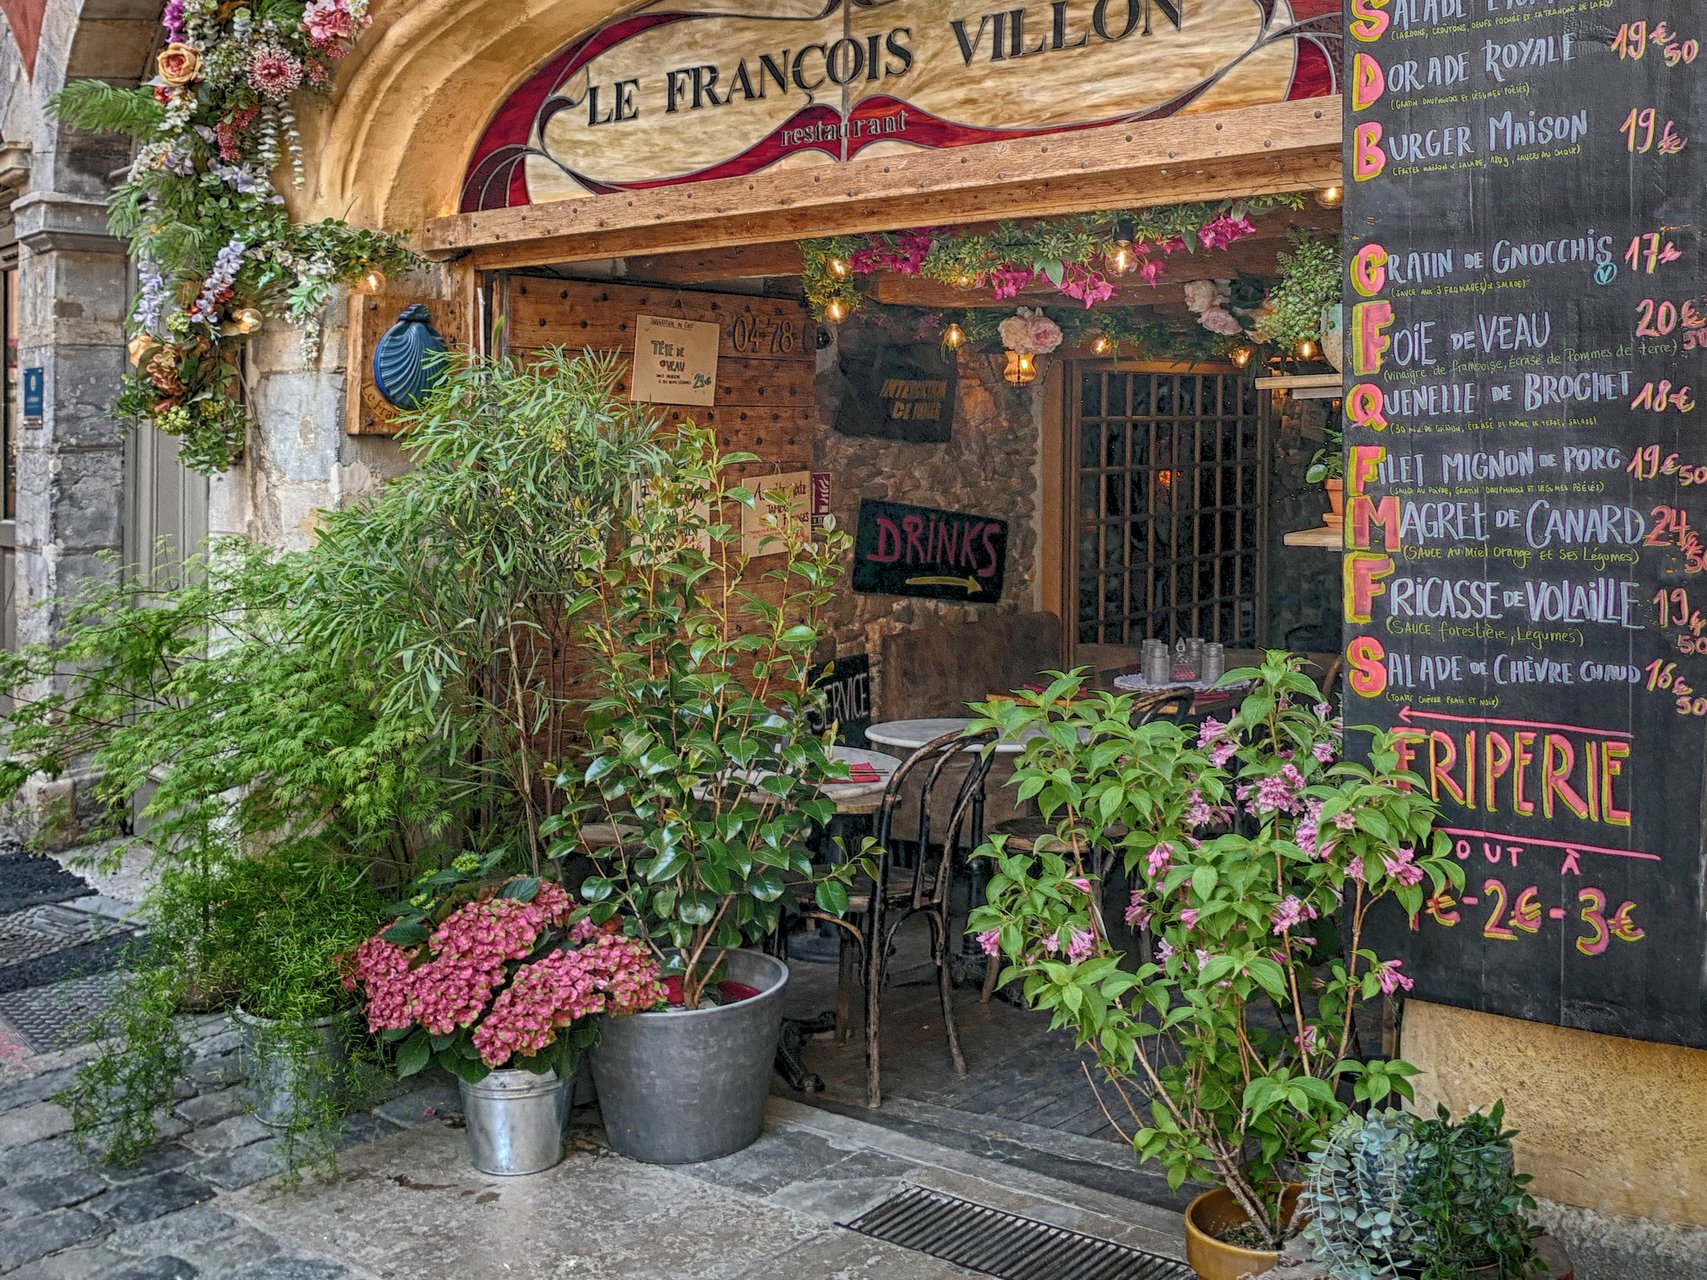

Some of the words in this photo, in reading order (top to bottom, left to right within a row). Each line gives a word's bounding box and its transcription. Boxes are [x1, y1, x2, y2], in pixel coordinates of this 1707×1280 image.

[1578, 2, 1588, 11] DE
[587, 78, 640, 128] LE
[665, 27, 914, 114] FRANÇOIS
[1352, 51, 1470, 112] DORADE
[1480, 32, 1576, 82] ROYALE
[1611, 20, 1699, 67] 19€50
[780, 109, 908, 147] restaurant
[1353, 121, 1475, 182] BURGER
[1619, 107, 1688, 155] 19€
[1541, 150, 1551, 159] AU
[1350, 242, 1453, 297] GRATIN
[1463, 252, 1484, 269] DE
[1624, 232, 1682, 274] 17€
[1391, 288, 1416, 298] (SAUCE
[1436, 285, 1442, 295] 3
[1496, 278, 1526, 290] SALADE)
[1450, 331, 1476, 351] DE
[1478, 312, 1551, 353] VEAU
[1384, 370, 1427, 385] (vinaigre
[1432, 365, 1447, 376] de
[1448, 357, 1508, 378] framboise,
[1547, 351, 1561, 364] de
[1564, 348, 1612, 361] Pommes
[1616, 344, 1632, 357] de
[1638, 339, 1678, 356] terre)
[362, 382, 376, 401] Le
[1345, 383, 1476, 432] QUENELLE
[1491, 385, 1512, 402] DE
[1524, 371, 1633, 412] BROCHET
[1630, 379, 1696, 413] 18€
[1347, 445, 1425, 497] FILET
[1442, 447, 1534, 484] MIGNON
[1539, 454, 1558, 467] DE
[1563, 447, 1621, 473] PORC
[1627, 444, 1707, 486] 19€50
[1495, 508, 1522, 528] DE
[1526, 499, 1645, 549] CANARD
[1402, 543, 1442, 561] (SAUCE
[1447, 547, 1461, 558] AU
[1464, 543, 1488, 559] Miel
[1493, 546, 1531, 569] Orange
[1583, 546, 1640, 571] Légumes)
[1503, 591, 1526, 607] DE
[1386, 616, 1431, 635] (SAUCE
[1346, 635, 1463, 698] SALADE
[1469, 661, 1489, 675] DE
[1494, 656, 1575, 685] CHÈVRE
[1579, 660, 1642, 684] CHAUD
[1389, 726, 1632, 827] FRIPERIE
[1456, 839, 1524, 867] OUT
